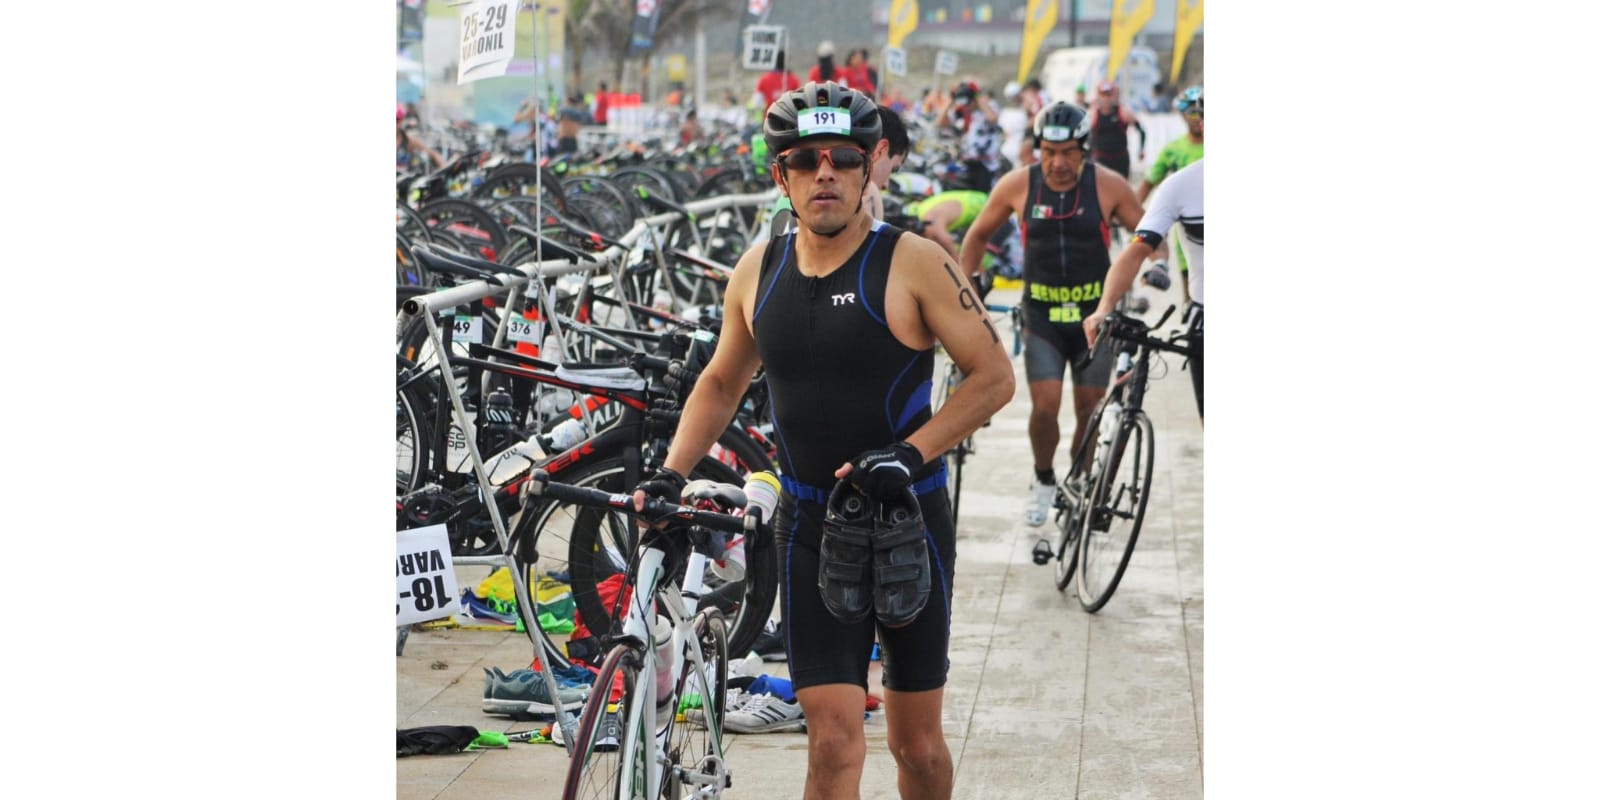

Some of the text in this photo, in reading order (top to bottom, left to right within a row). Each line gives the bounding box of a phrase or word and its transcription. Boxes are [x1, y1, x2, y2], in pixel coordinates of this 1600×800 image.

[463, 4, 507, 42] 25-29
[814, 112, 836, 125] 191
[831, 292, 856, 307] TYR
[1030, 281, 1101, 303] MENDOZA
[943, 262, 999, 345] 191
[1049, 306, 1081, 323] MEX
[510, 322, 530, 335] 376
[608, 494, 629, 504] BH
[397, 549, 446, 577] VAR
[397, 574, 453, 616] 18-
